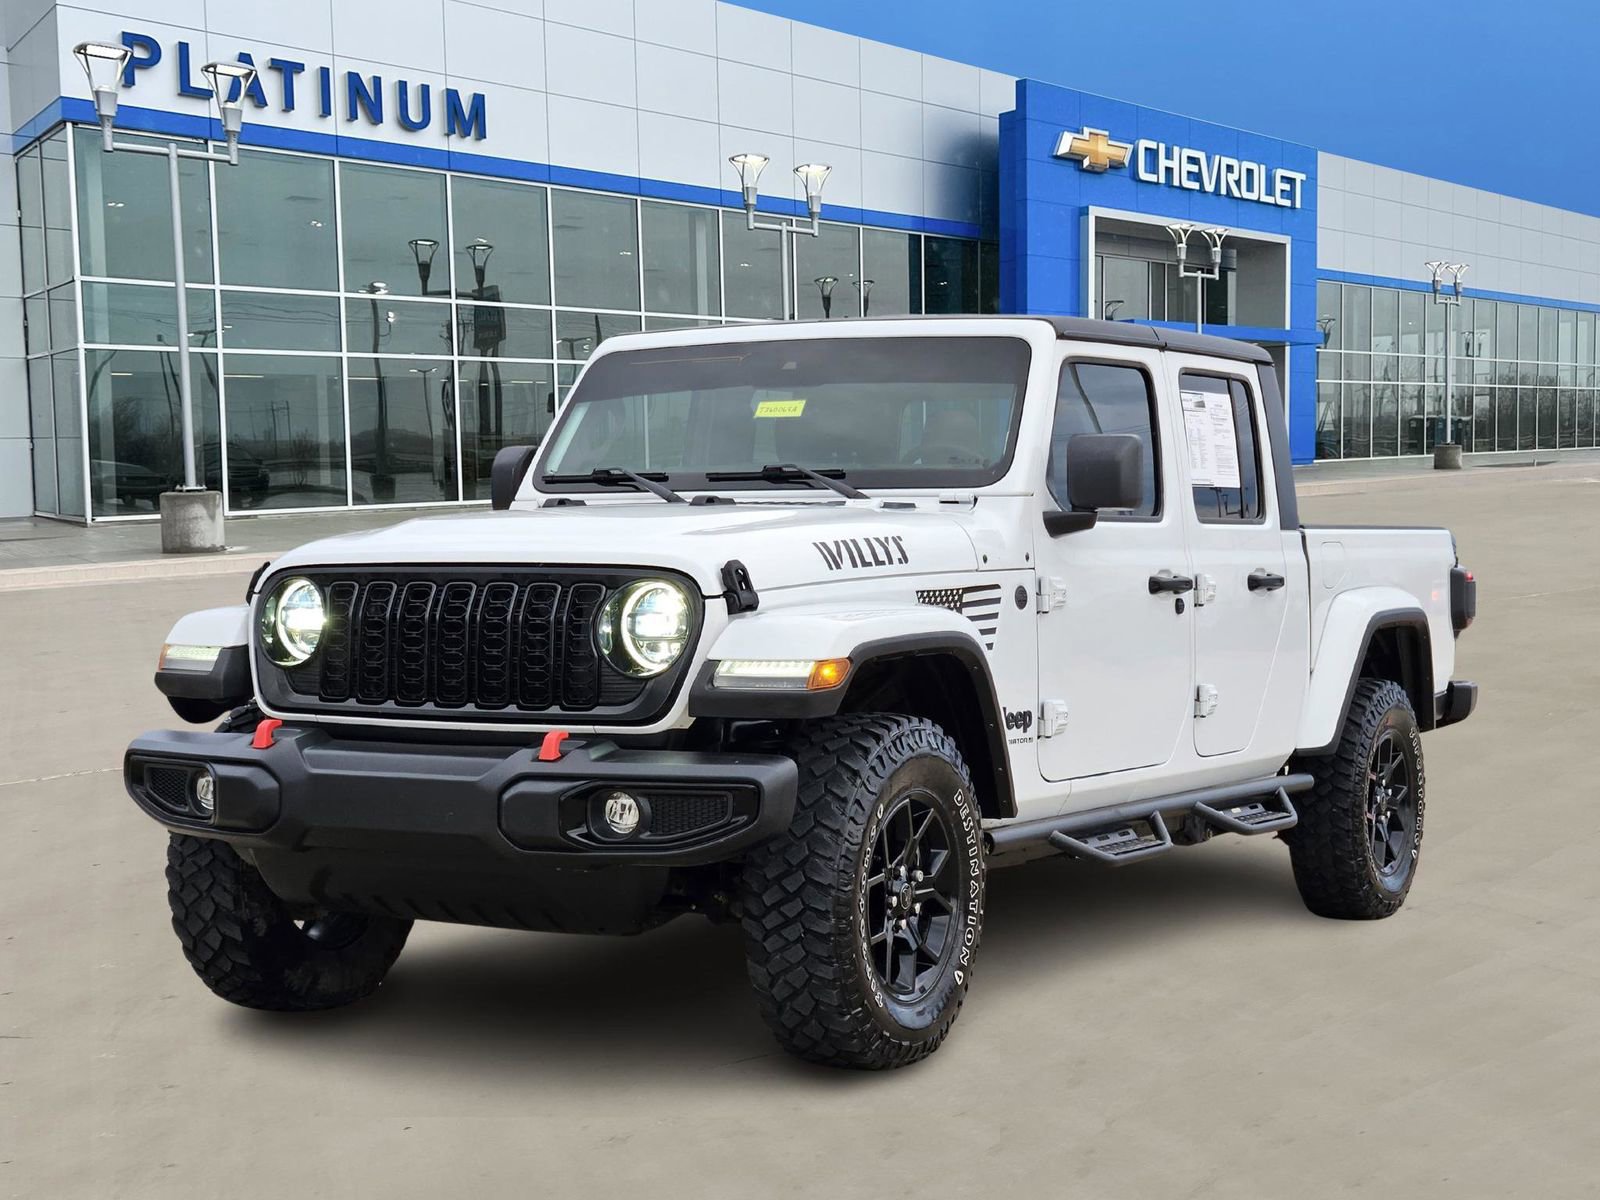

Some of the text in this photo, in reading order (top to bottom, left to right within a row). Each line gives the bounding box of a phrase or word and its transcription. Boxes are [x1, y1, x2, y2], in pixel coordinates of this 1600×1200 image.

[120, 31, 488, 141] PLATINUM
[1135, 138, 1307, 209] CHEVROLET
[812, 535, 909, 571] WILLYS
[953, 788, 980, 967] DESTINATION
